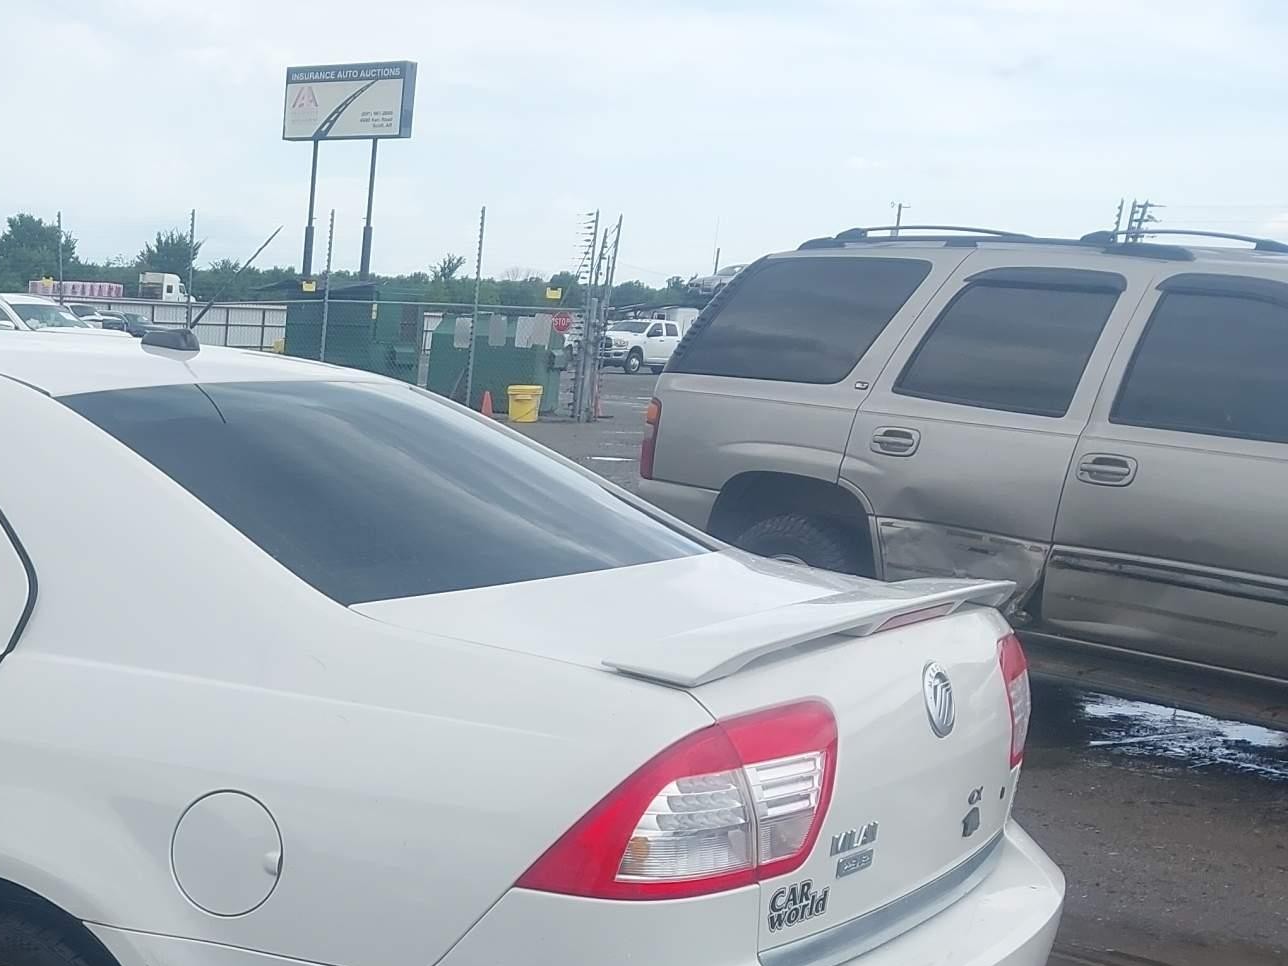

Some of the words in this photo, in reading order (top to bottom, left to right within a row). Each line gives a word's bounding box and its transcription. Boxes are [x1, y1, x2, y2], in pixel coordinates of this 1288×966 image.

[291, 71, 335, 81] INSURANCE
[337, 70, 359, 79] AUTO
[359, 67, 401, 77] AUCTIONS
[552, 317, 570, 327] STOP
[770, 880, 814, 913] CAR
